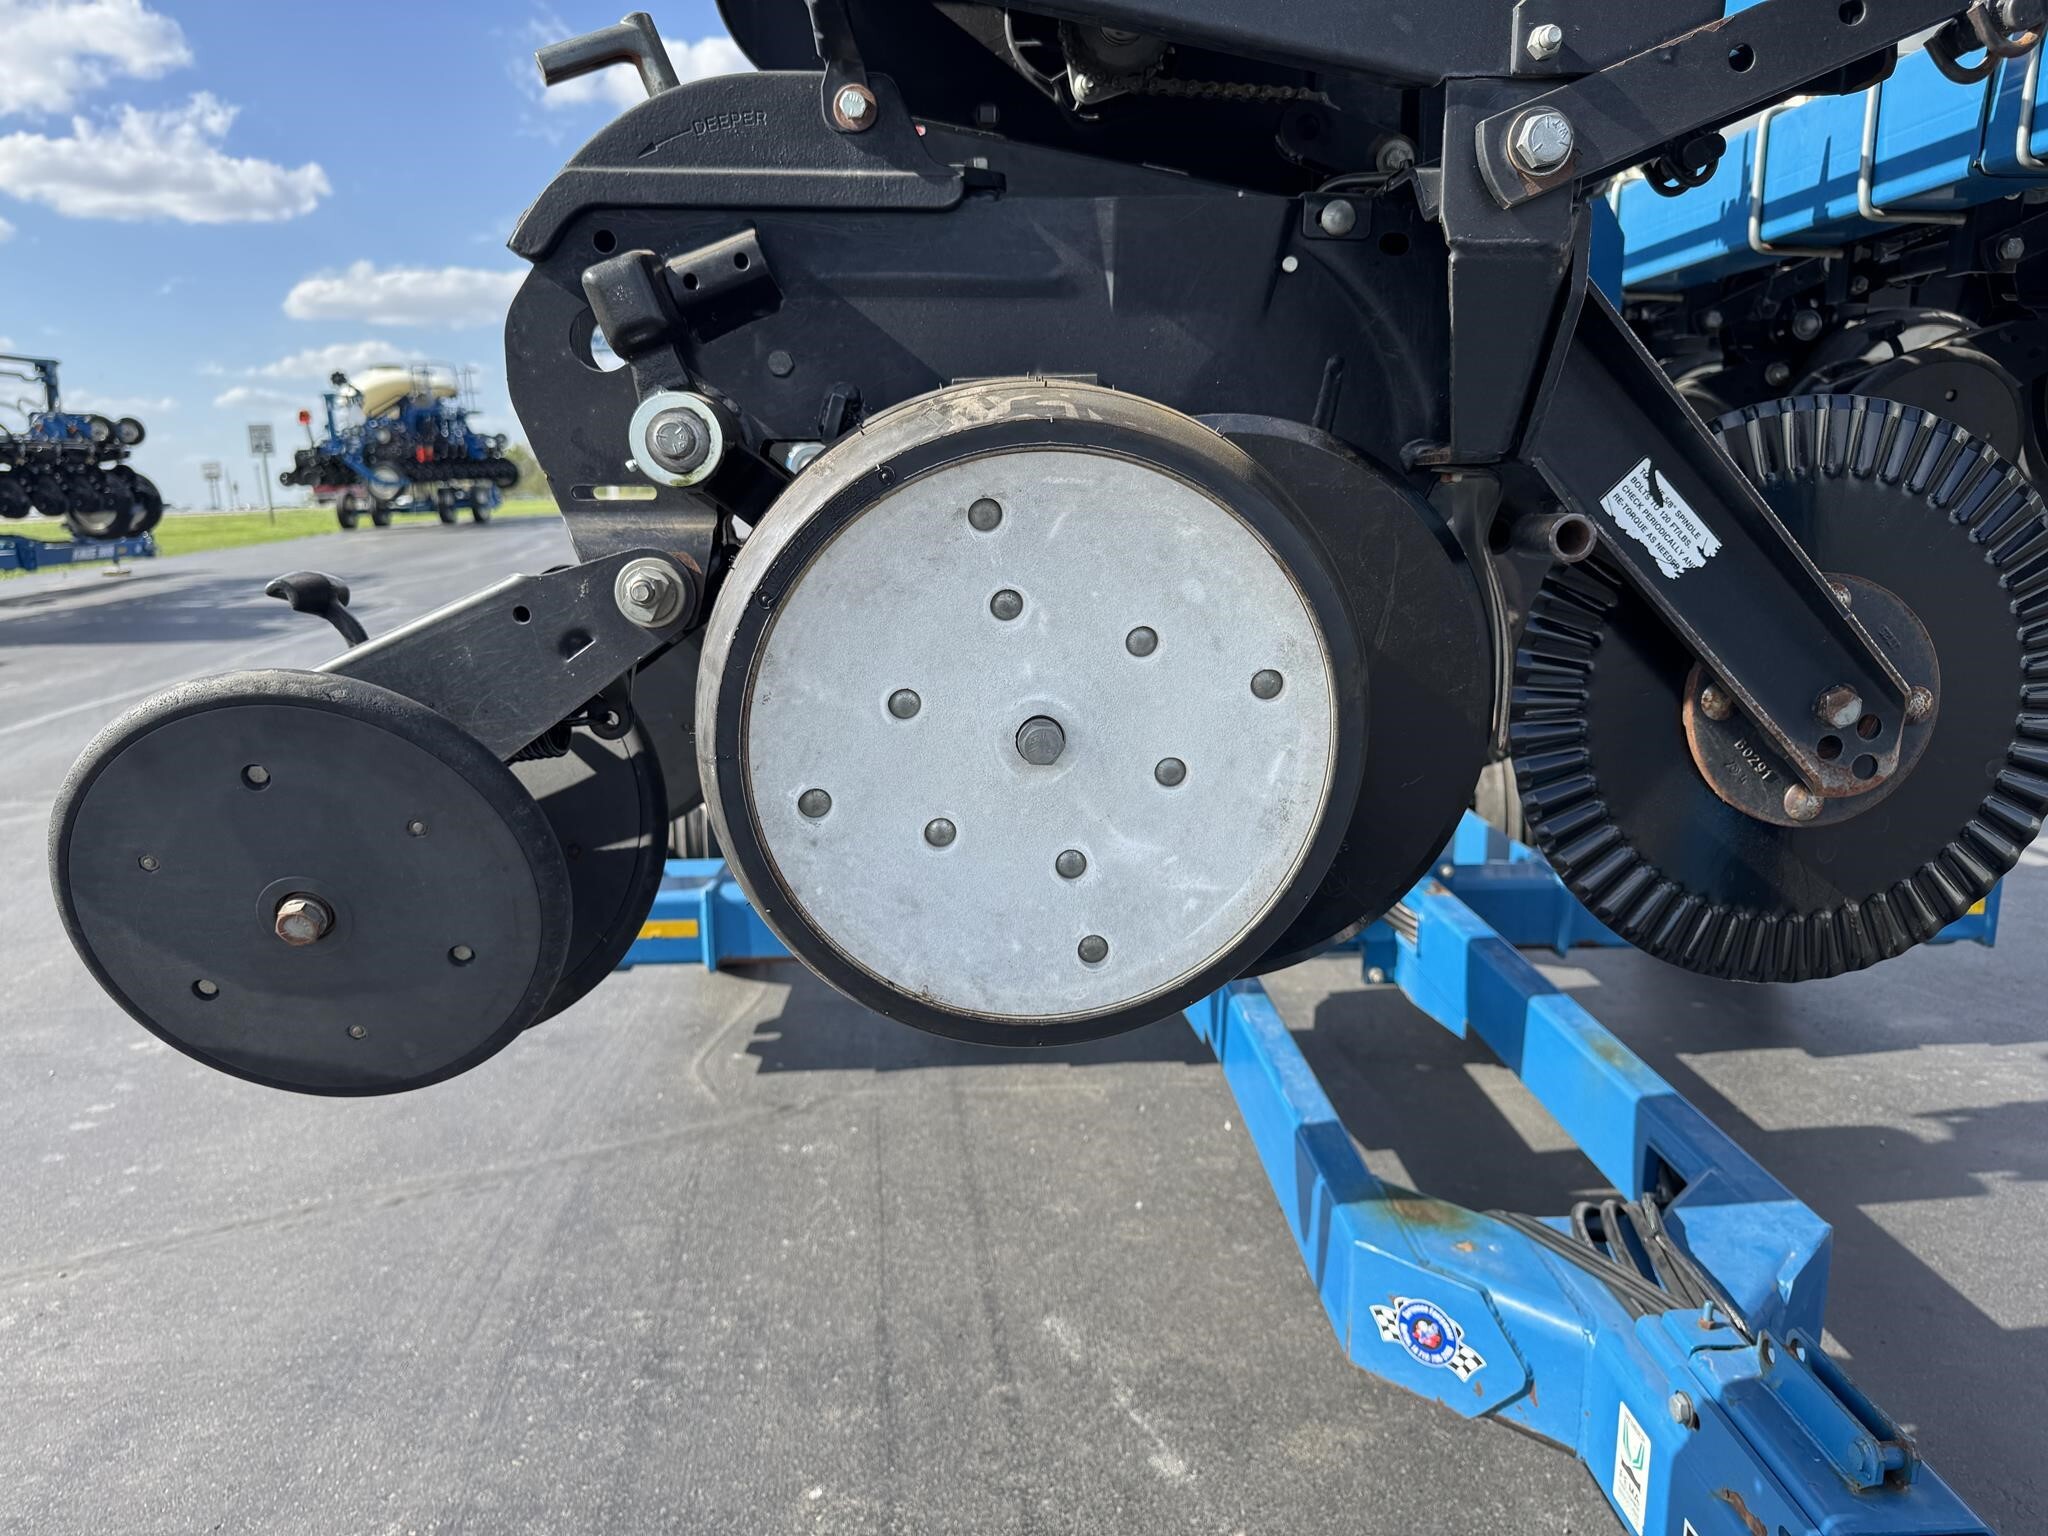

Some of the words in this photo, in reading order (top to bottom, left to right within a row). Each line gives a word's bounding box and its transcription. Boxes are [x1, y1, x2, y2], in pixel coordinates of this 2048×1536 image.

[693, 110, 768, 137] DEEPER
[1612, 493, 1647, 533] RE-TORQUE
[1646, 531, 1657, 543] AS
[1621, 484, 1643, 510] CHECK
[1642, 508, 1685, 557] PERIODICALLY
[1630, 476, 1651, 500] BOLTS
[1650, 499, 1661, 511] TO
[1659, 510, 1671, 523] 120
[1670, 521, 1693, 548] FT/LBS.
[1675, 509, 1701, 539] SPINDLE
